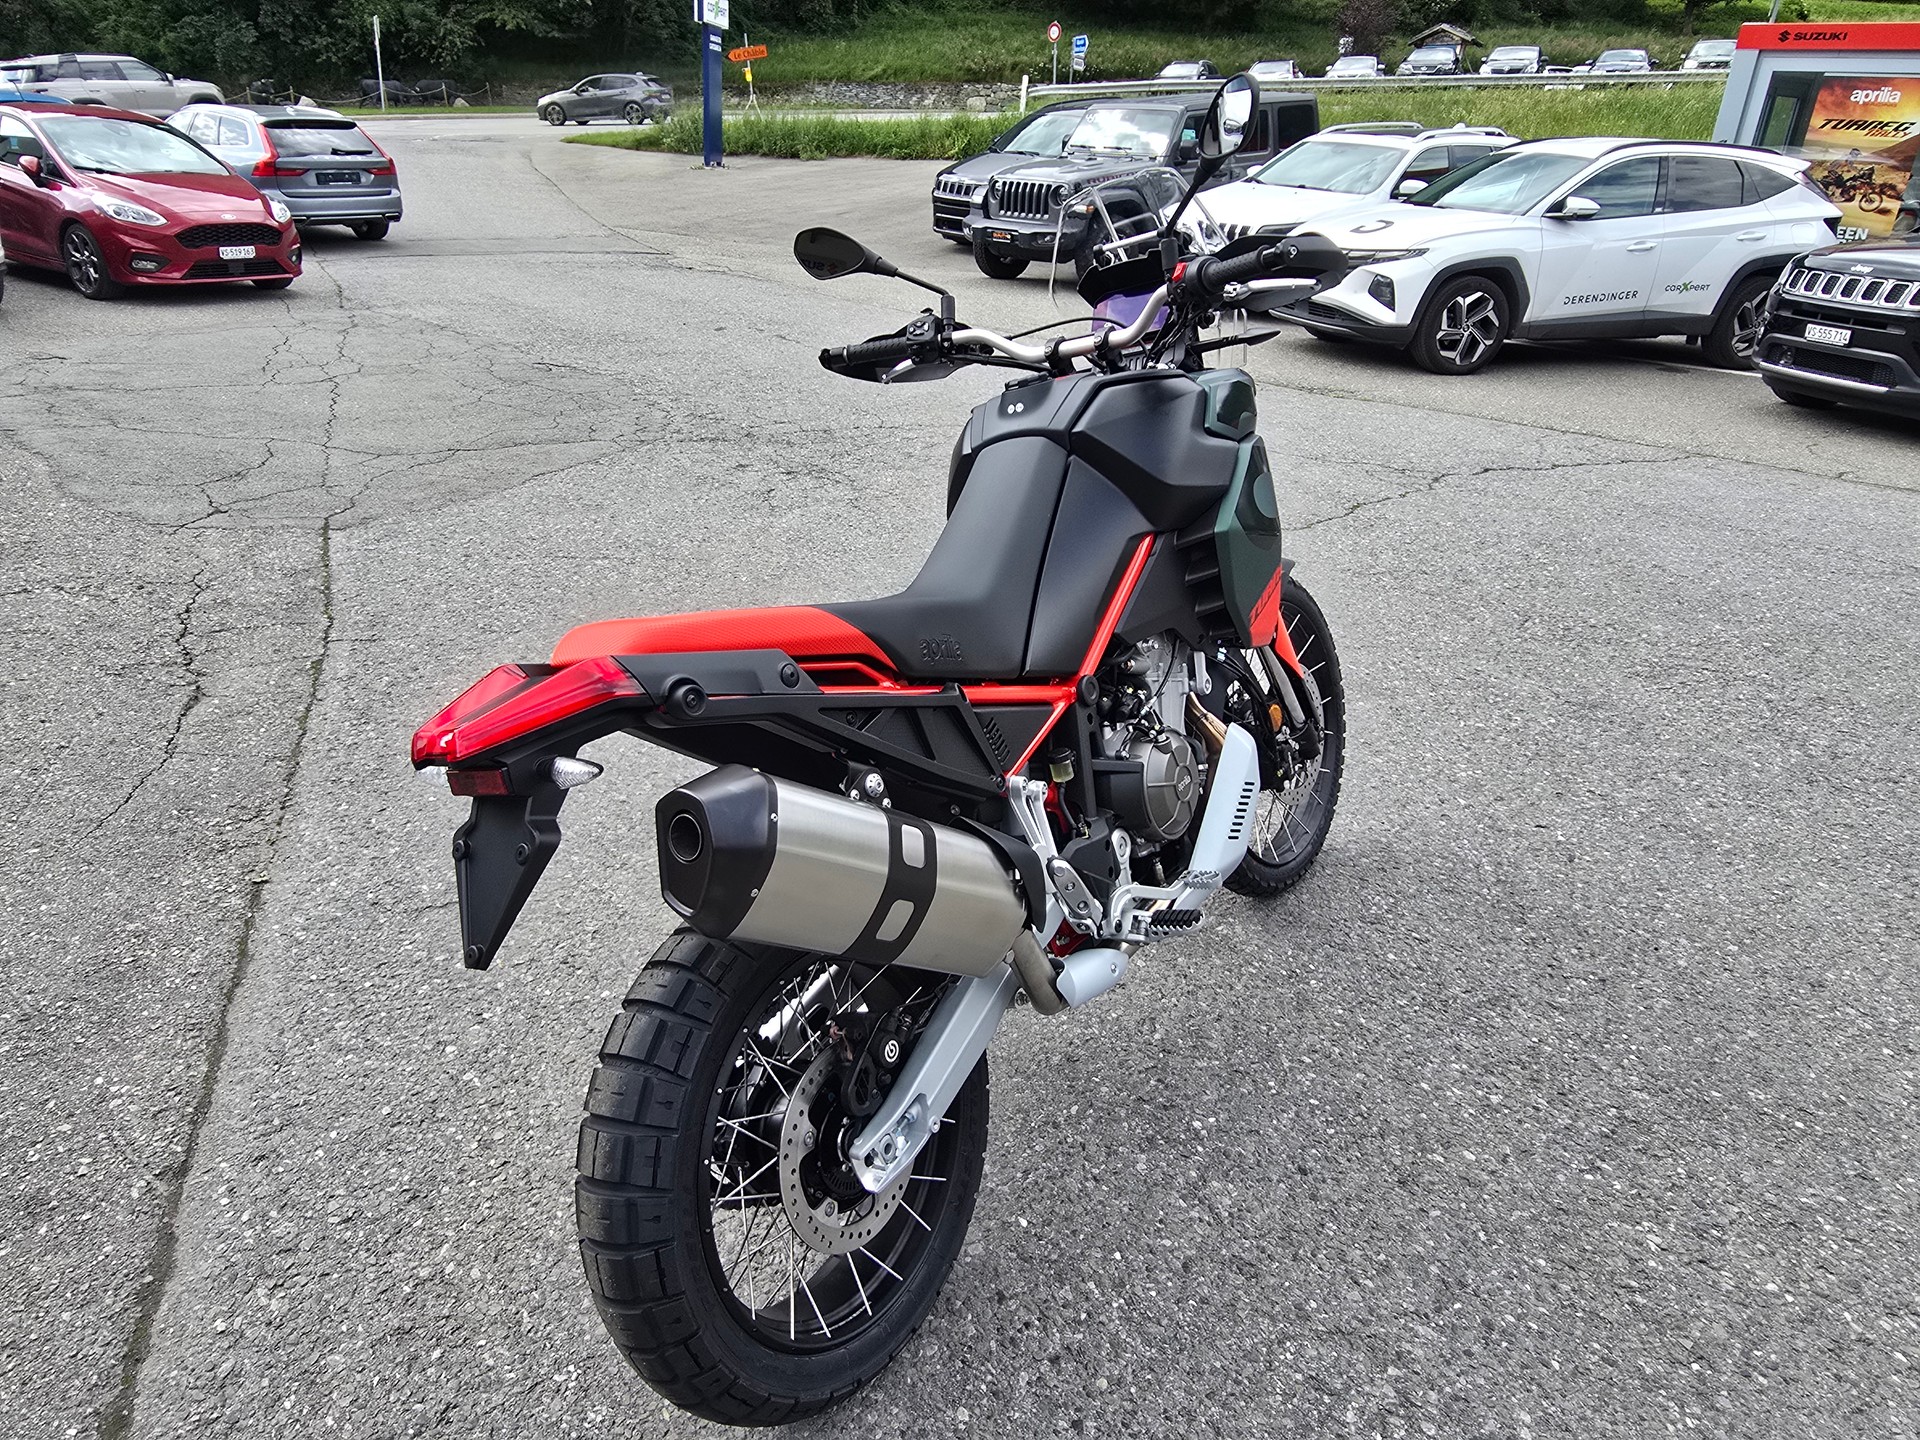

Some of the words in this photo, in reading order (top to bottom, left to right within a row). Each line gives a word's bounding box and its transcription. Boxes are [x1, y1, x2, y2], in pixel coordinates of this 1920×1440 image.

[1793, 32, 1848, 41] SUZUKI
[733, 52, 741, 60] Le
[1850, 87, 1901, 105] aprilia
[1818, 118, 1916, 132] TUAREG
[1563, 290, 1639, 305] DERENDINGER
[919, 634, 962, 664] aprilia
